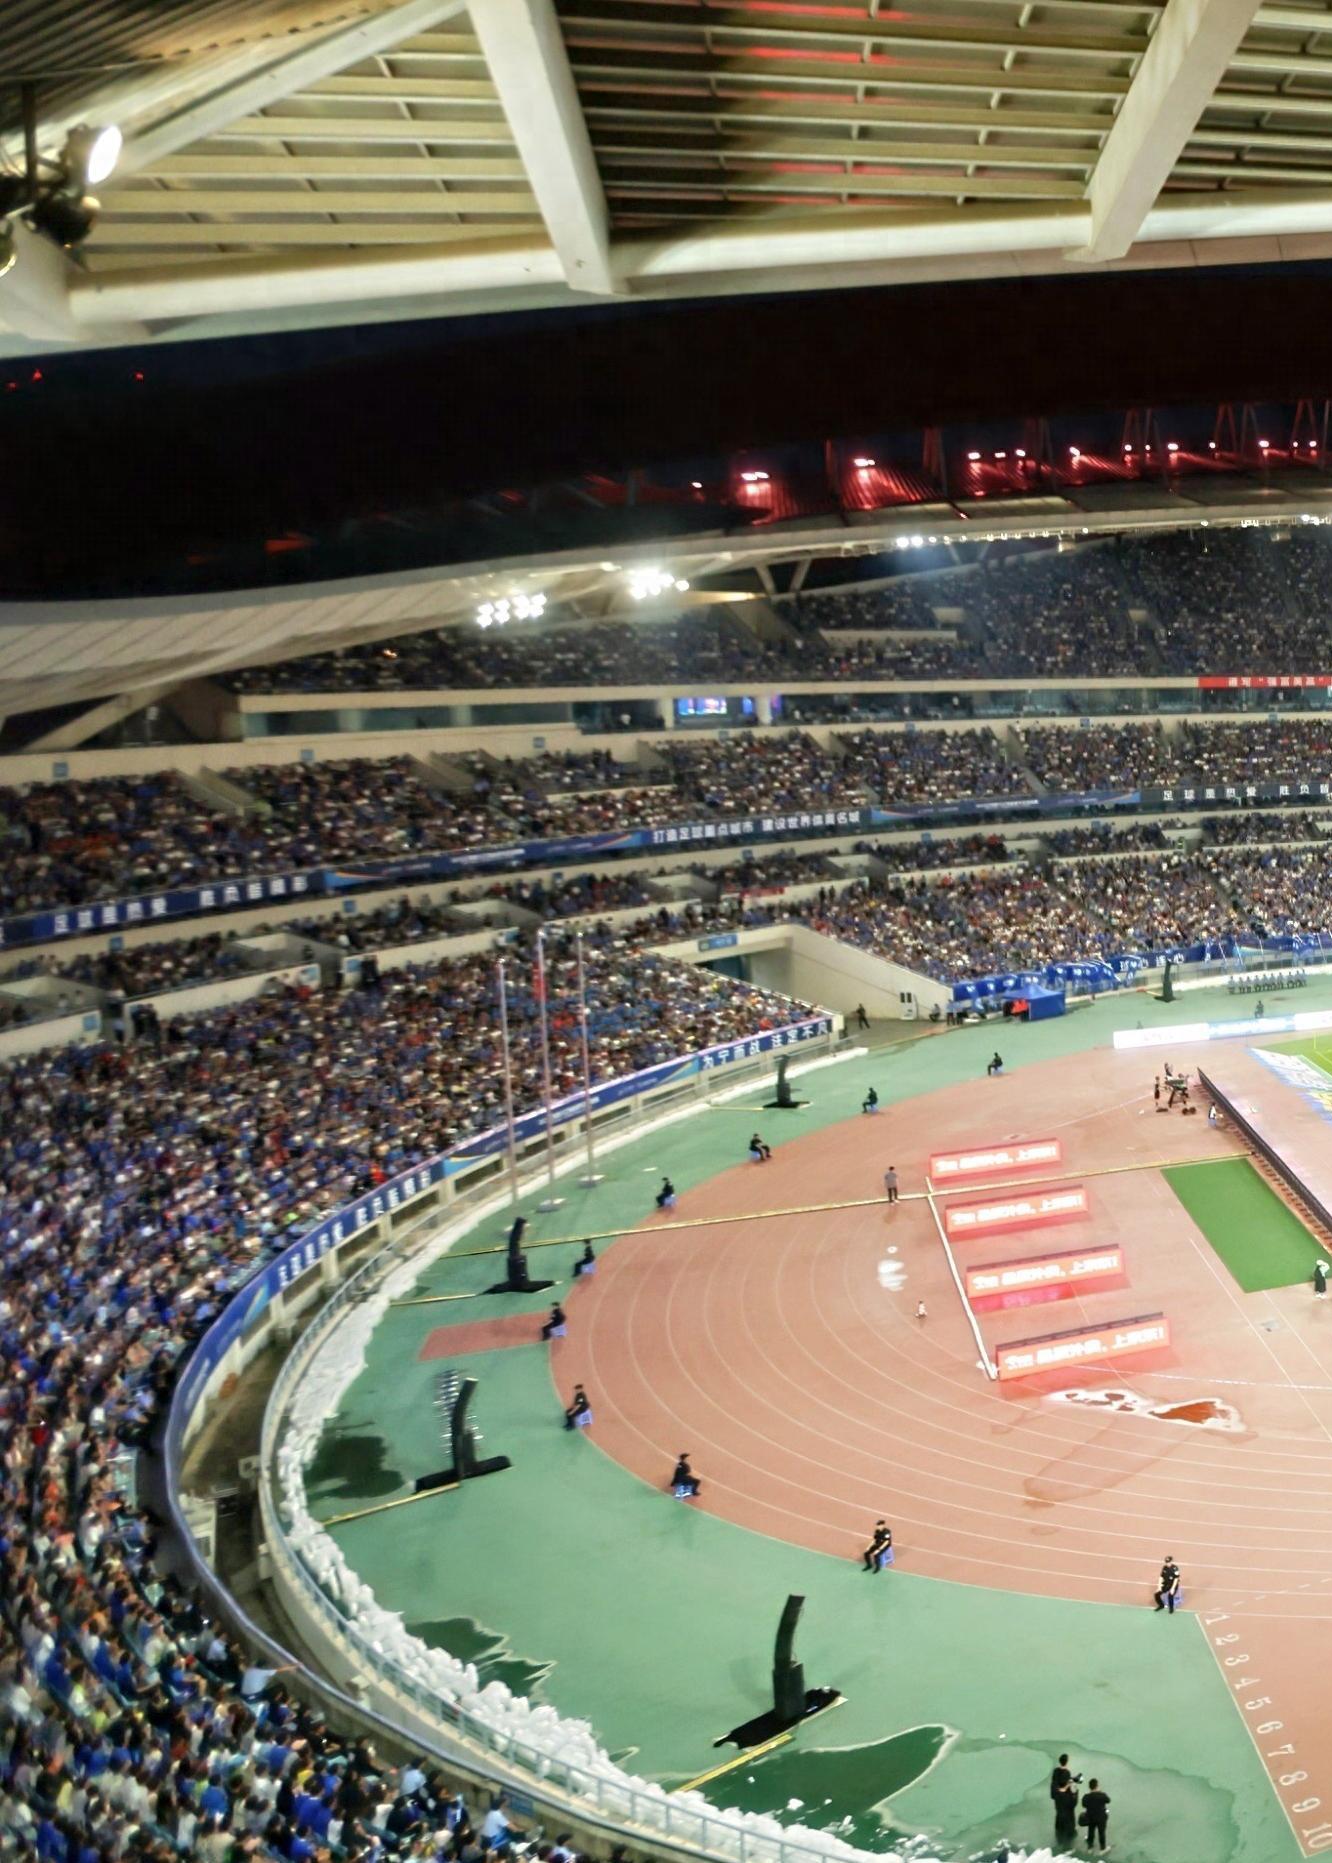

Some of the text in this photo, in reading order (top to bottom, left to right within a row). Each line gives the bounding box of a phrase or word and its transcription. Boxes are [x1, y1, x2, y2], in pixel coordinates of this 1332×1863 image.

[1205, 1614, 1231, 1625] 1
[1215, 1633, 1240, 1646] 2
[1224, 1654, 1250, 1666] 3
[1234, 1677, 1261, 1690] 4
[1245, 1696, 1272, 1710] 5
[1256, 1720, 1284, 1734] 6
[1267, 1743, 1295, 1757] 7
[1279, 1771, 1308, 1786] 8
[1292, 1797, 1321, 1813] 9
